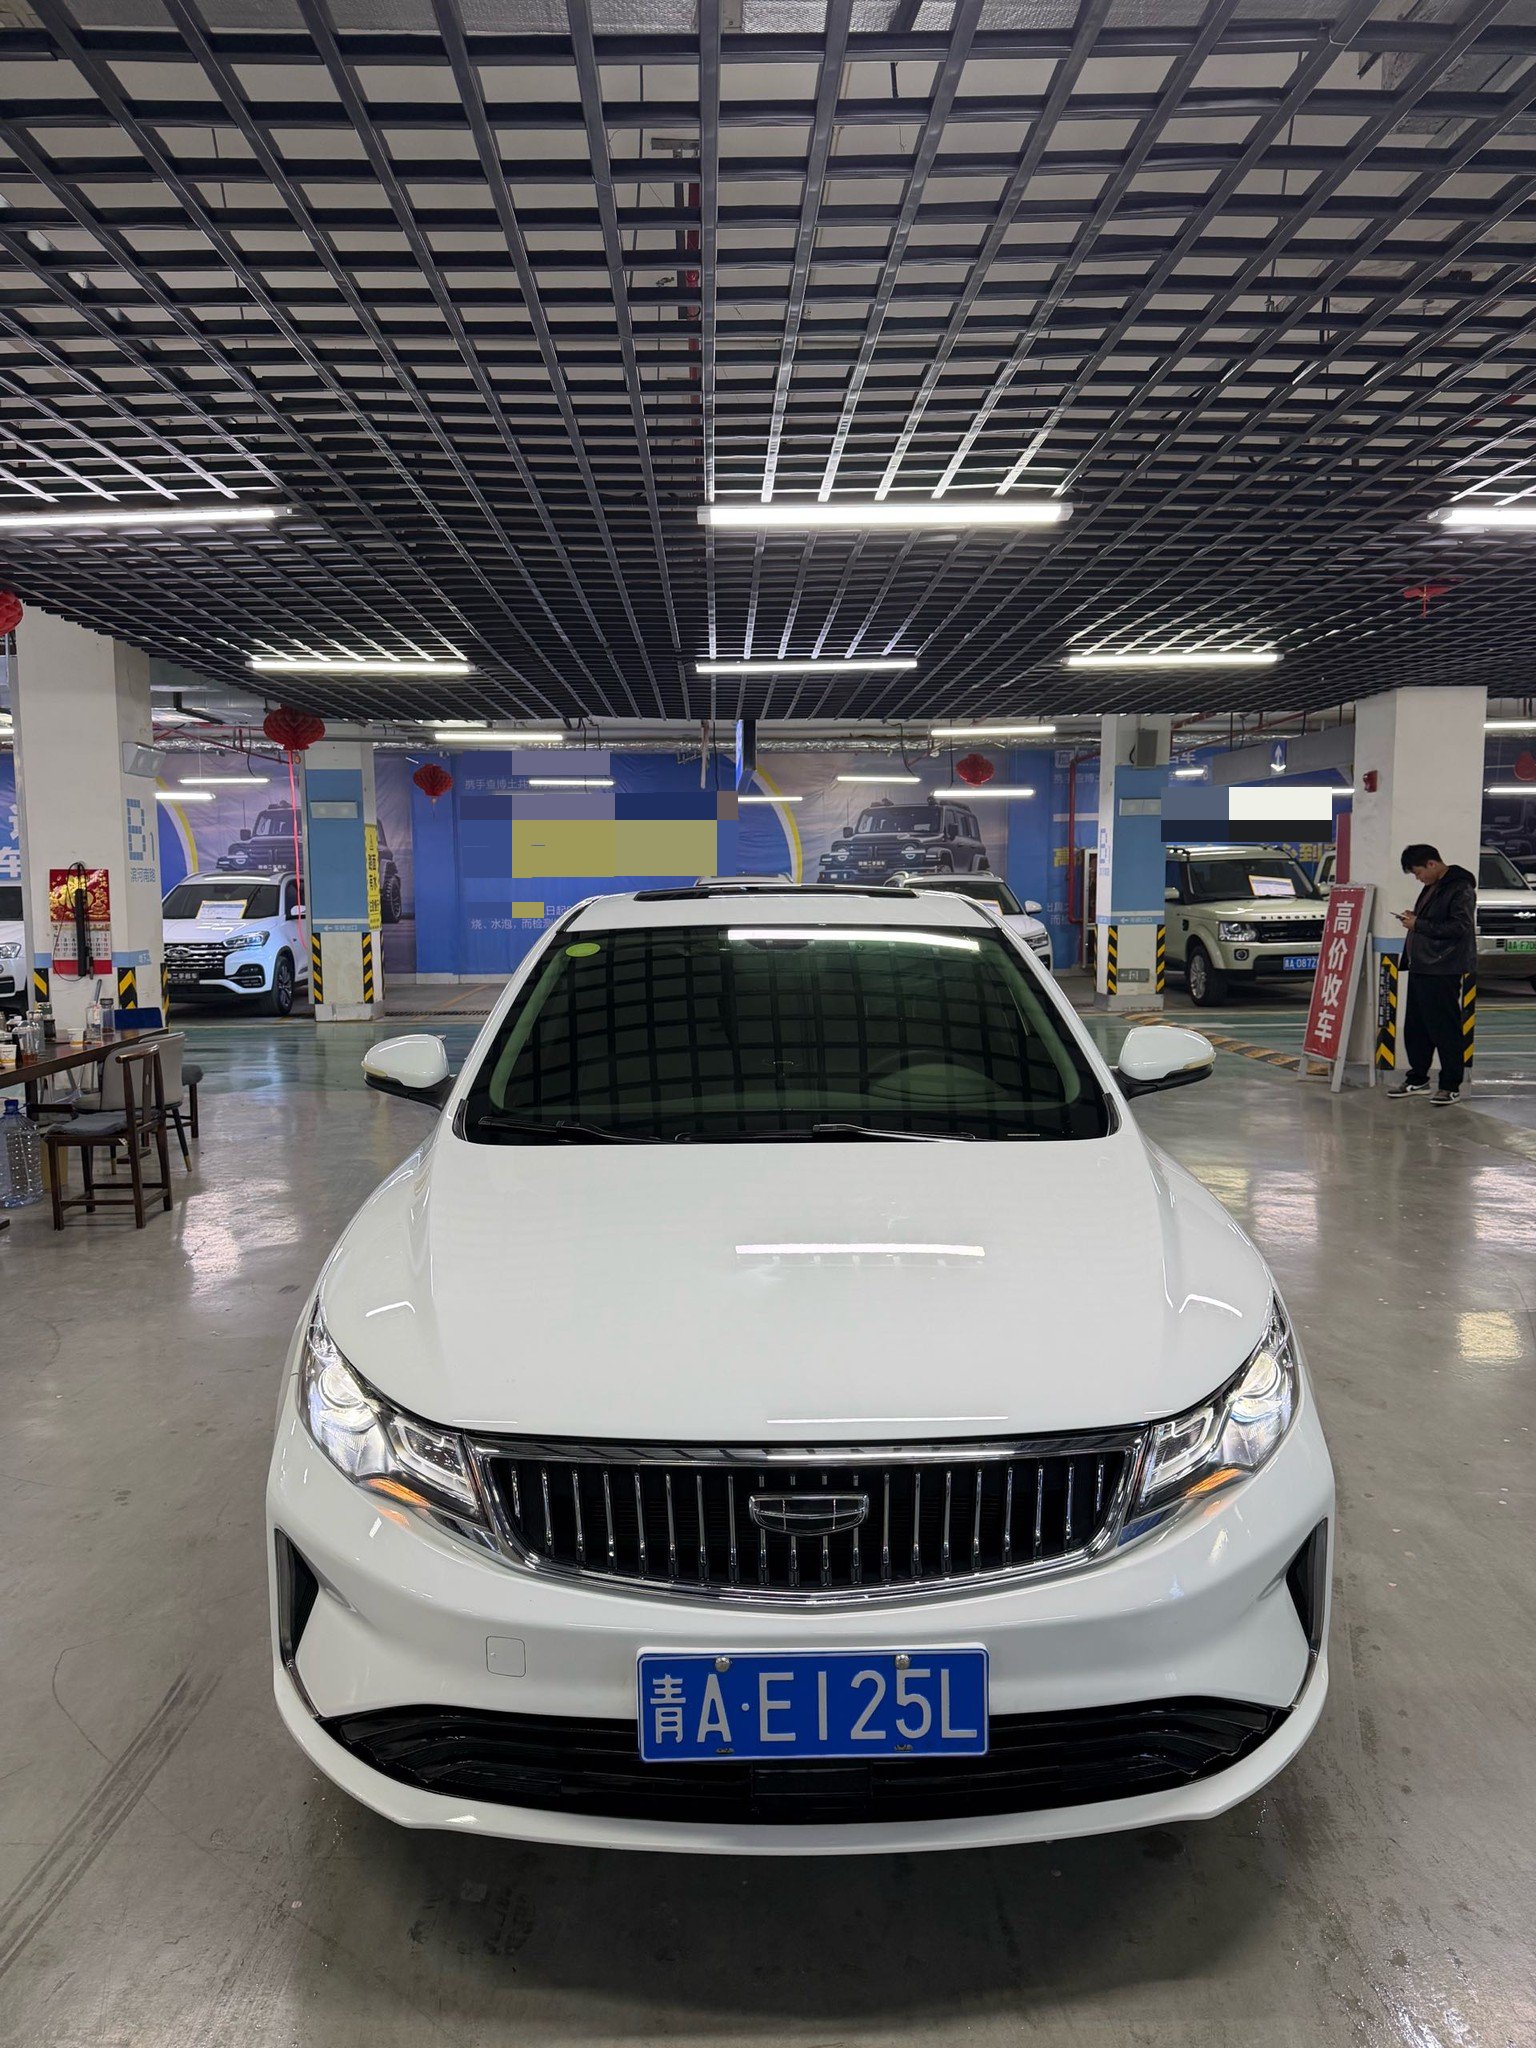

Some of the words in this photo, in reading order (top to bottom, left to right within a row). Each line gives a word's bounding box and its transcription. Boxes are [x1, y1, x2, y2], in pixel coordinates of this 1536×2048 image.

[1314, 901, 1356, 1044] 高价收车
[650, 1667, 978, 1744] 青A·E125L
